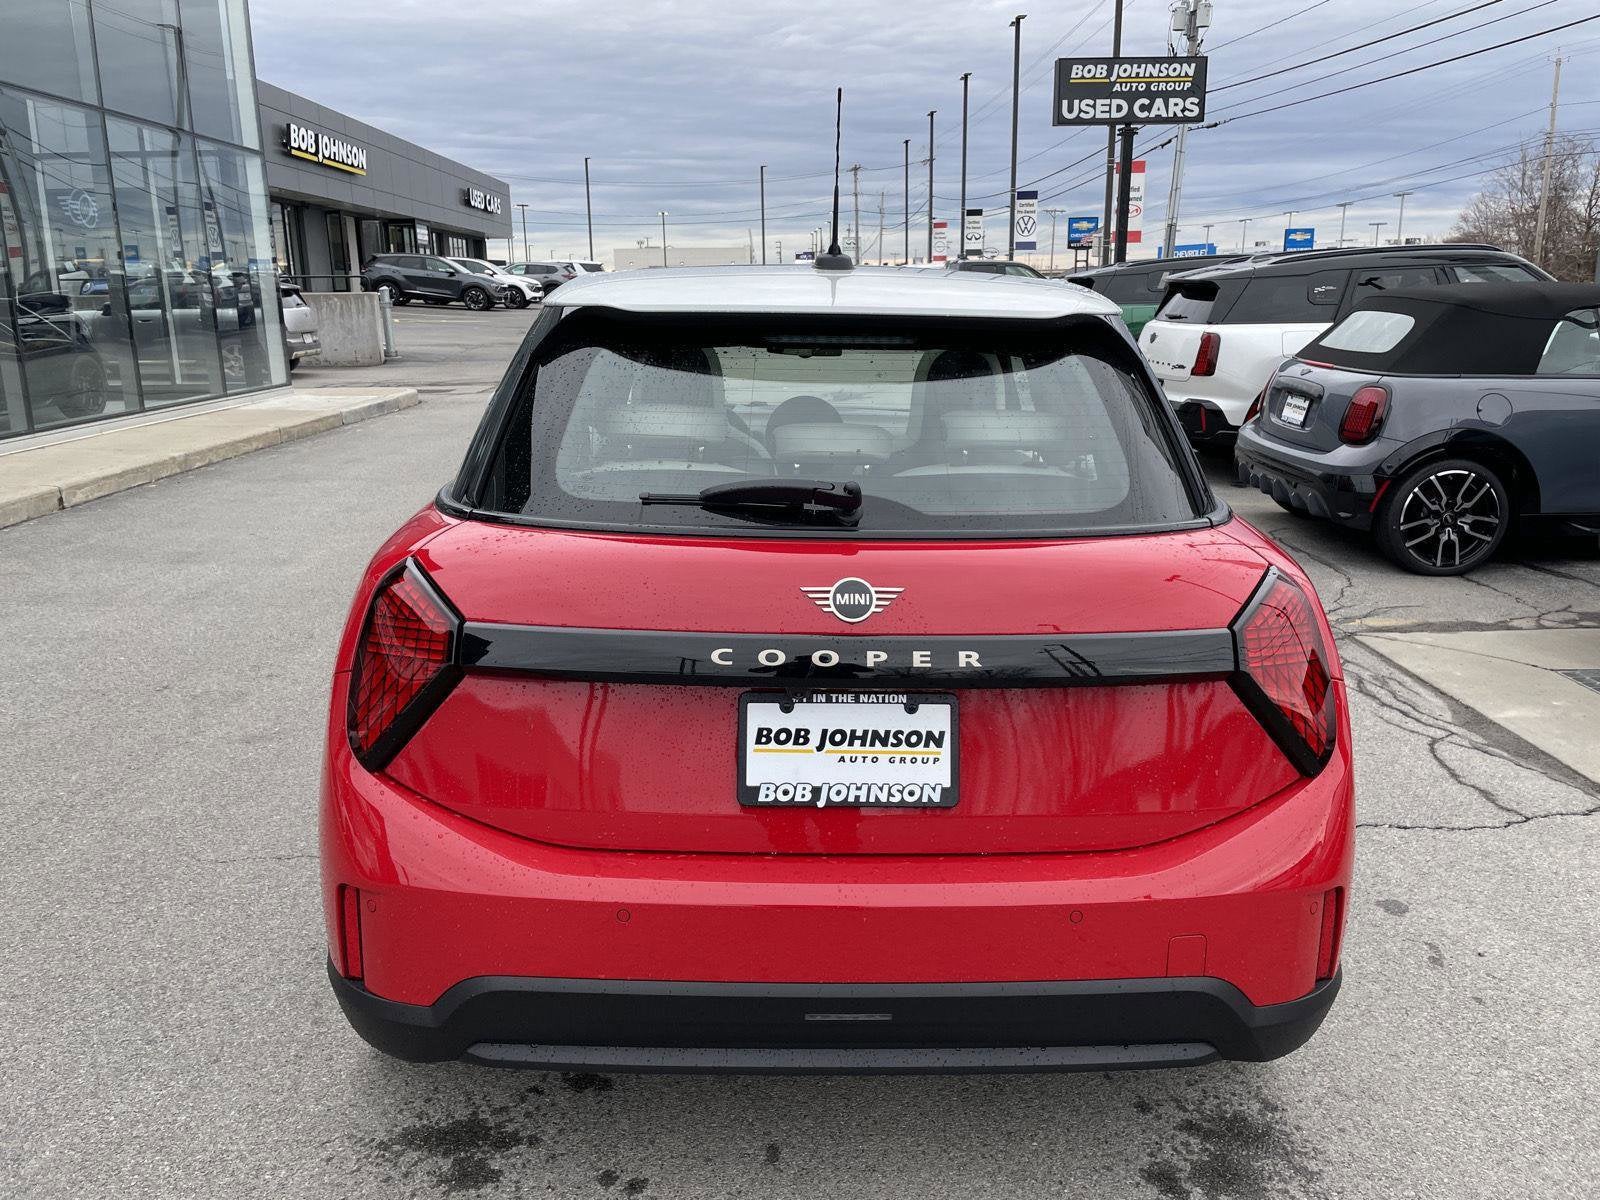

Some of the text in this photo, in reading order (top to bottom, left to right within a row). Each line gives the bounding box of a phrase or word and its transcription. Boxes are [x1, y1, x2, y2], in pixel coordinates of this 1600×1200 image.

[1071, 63, 1196, 82] BOB JOHNSON
[1112, 82, 1192, 91] AUTO GROUP
[1061, 97, 1200, 120] USED CARS
[290, 123, 367, 170] BOB JOHNSON
[469, 187, 501, 214] USED CARS
[836, 593, 870, 605] MINI
[710, 648, 982, 667] COOPER
[812, 693, 826, 703] IN
[830, 694, 855, 703] THE
[859, 694, 907, 703] NATION
[754, 727, 945, 752] BOB JOHNSON
[837, 755, 941, 765] AUTO GROUP
[757, 783, 943, 808] BOB JOHNSON
